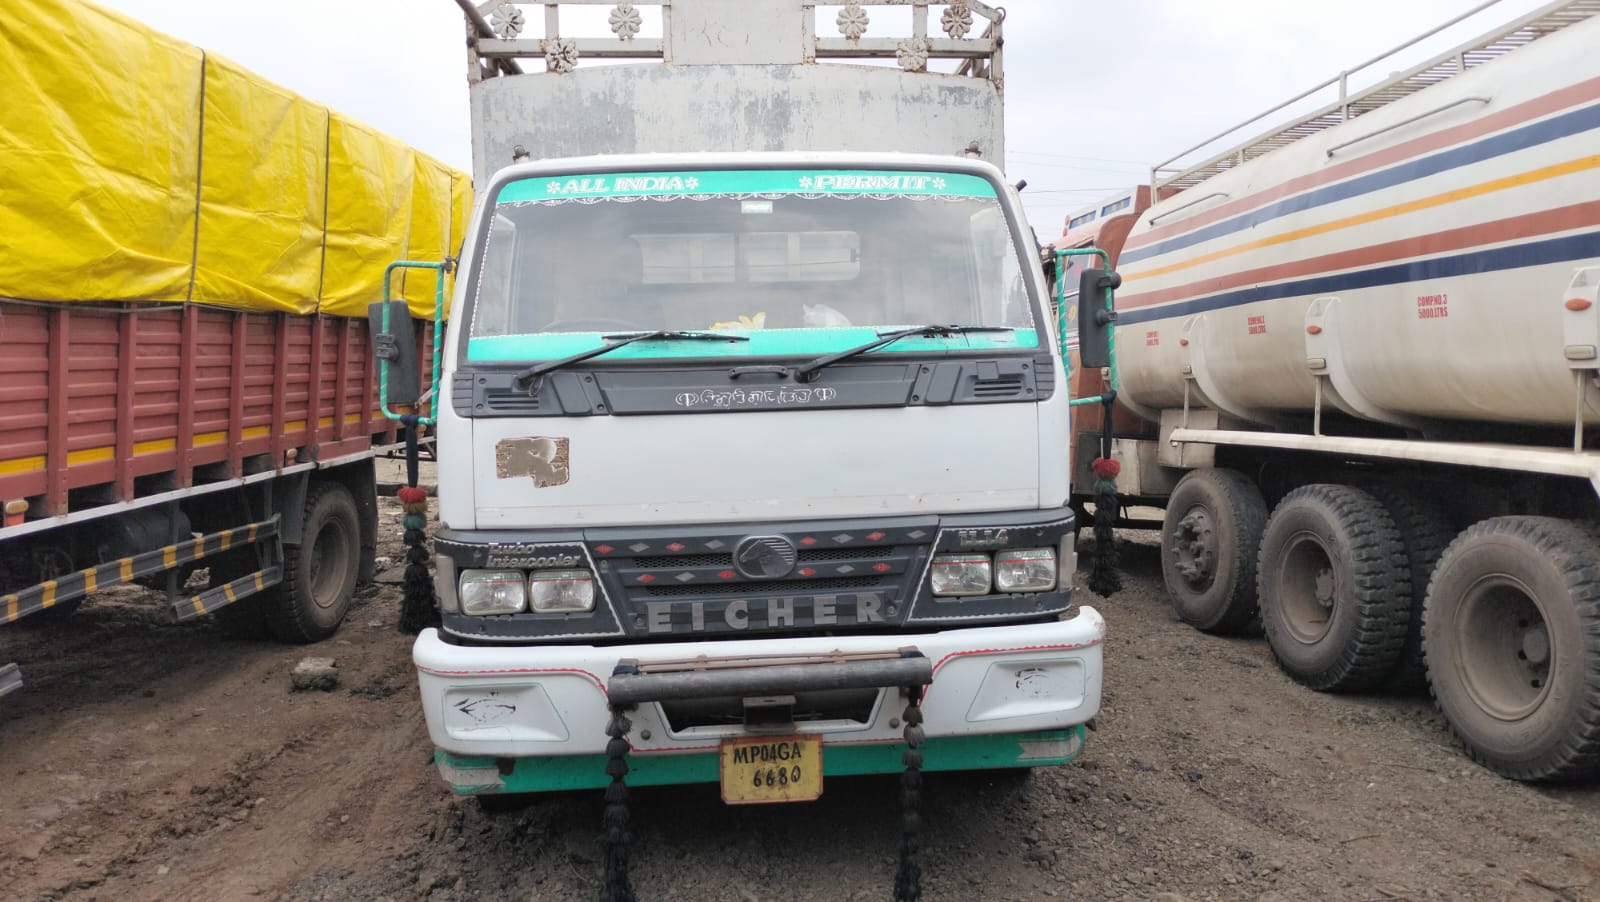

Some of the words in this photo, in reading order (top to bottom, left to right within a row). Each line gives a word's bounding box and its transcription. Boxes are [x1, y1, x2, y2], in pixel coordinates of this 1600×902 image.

[558, 178, 611, 194] ALL
[612, 175, 687, 191] INDIA
[812, 173, 932, 190] PERMIT
[647, 591, 885, 634] EICHER
[733, 742, 802, 765] MP04GA
[753, 765, 802, 788] 6680
